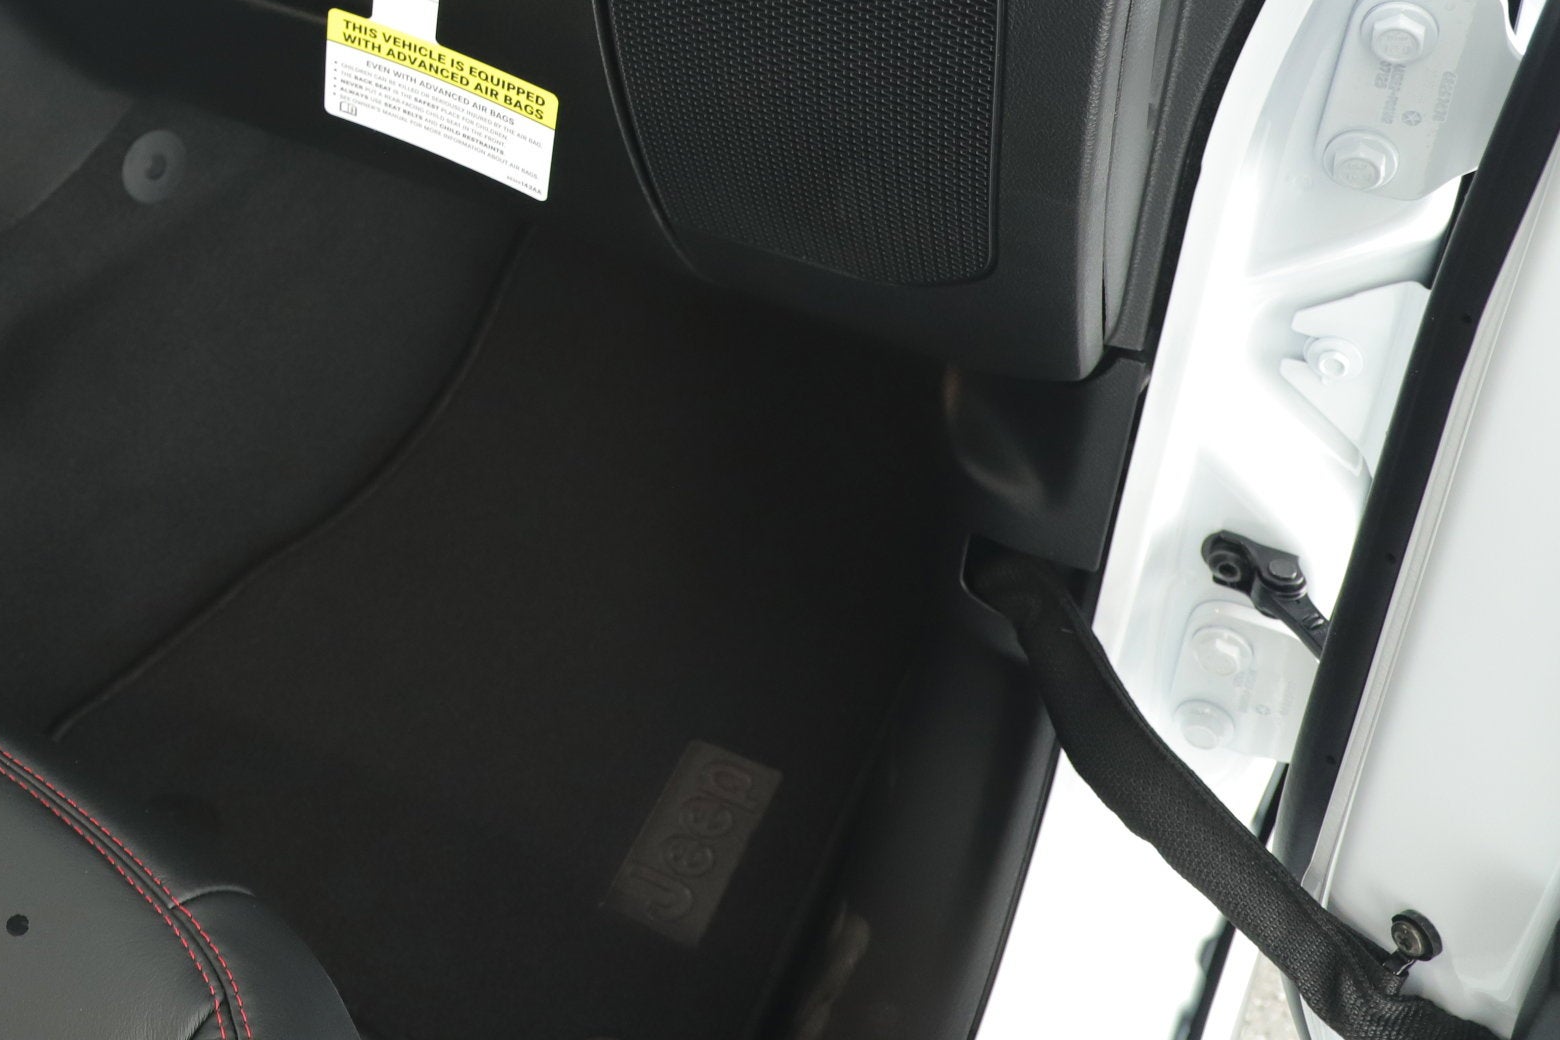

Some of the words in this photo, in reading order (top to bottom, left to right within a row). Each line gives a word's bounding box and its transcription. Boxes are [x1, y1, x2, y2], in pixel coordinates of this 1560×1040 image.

[343, 31, 381, 53] WITH
[387, 47, 469, 87] ADVANCED
[475, 81, 499, 100] AIR
[504, 94, 544, 120] BAGS
[344, 19, 377, 39] THIS
[383, 33, 446, 64] VEHICLE
[450, 58, 465, 72] IS
[469, 66, 546, 107] EQUIPPED
[366, 60, 390, 74] EVEN
[393, 69, 417, 84] WITH
[419, 79, 469, 105] ADVANCED
[472, 101, 487, 113] AIR
[490, 109, 515, 125] BAGS
